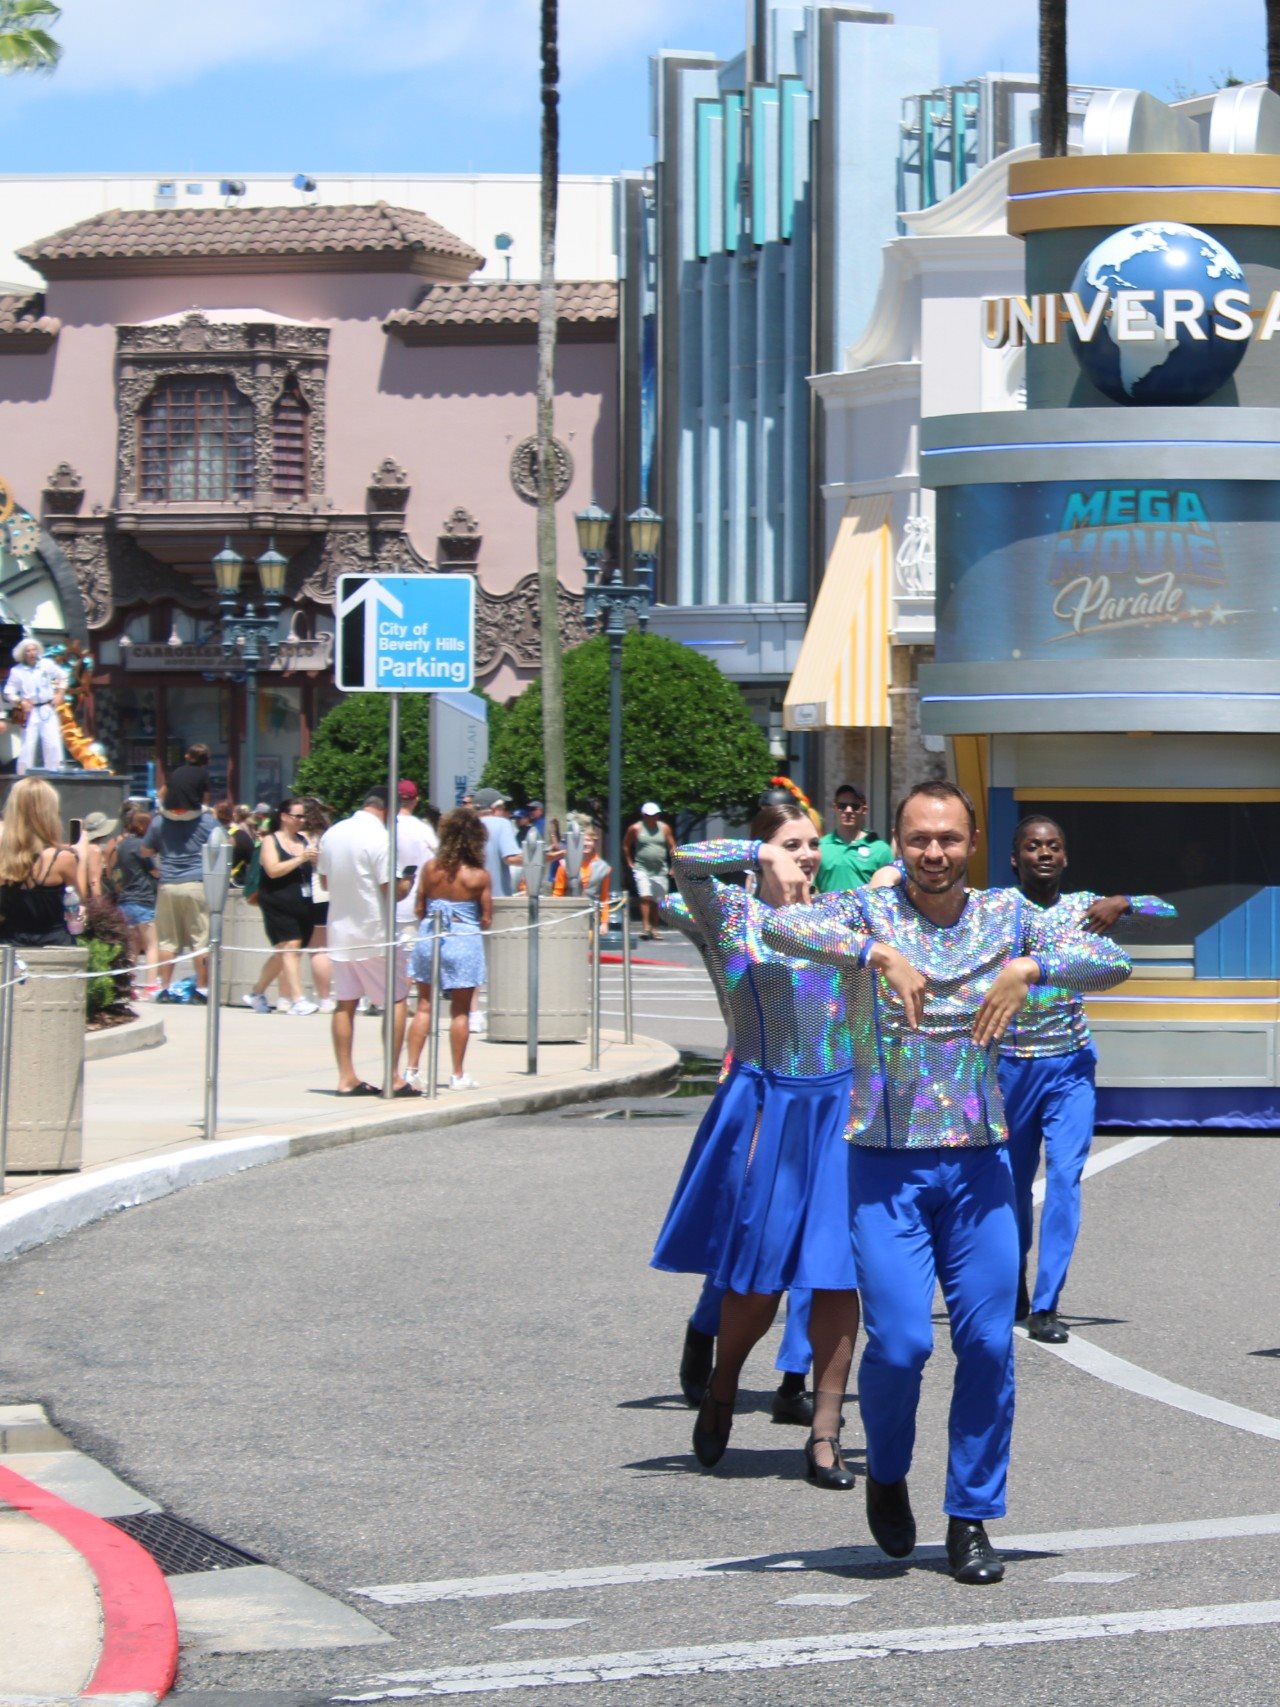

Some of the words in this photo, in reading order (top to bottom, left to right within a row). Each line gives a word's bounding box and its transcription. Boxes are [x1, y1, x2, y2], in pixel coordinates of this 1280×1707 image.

[1060, 489, 1212, 532] MEGA
[1052, 529, 1225, 584] MOVIE
[1053, 572, 1184, 633] Parade
[379, 622, 408, 638] City
[412, 622, 429, 636] of
[379, 637, 431, 653] Beverly
[436, 637, 466, 651] Hills
[379, 656, 466, 682] Parking
